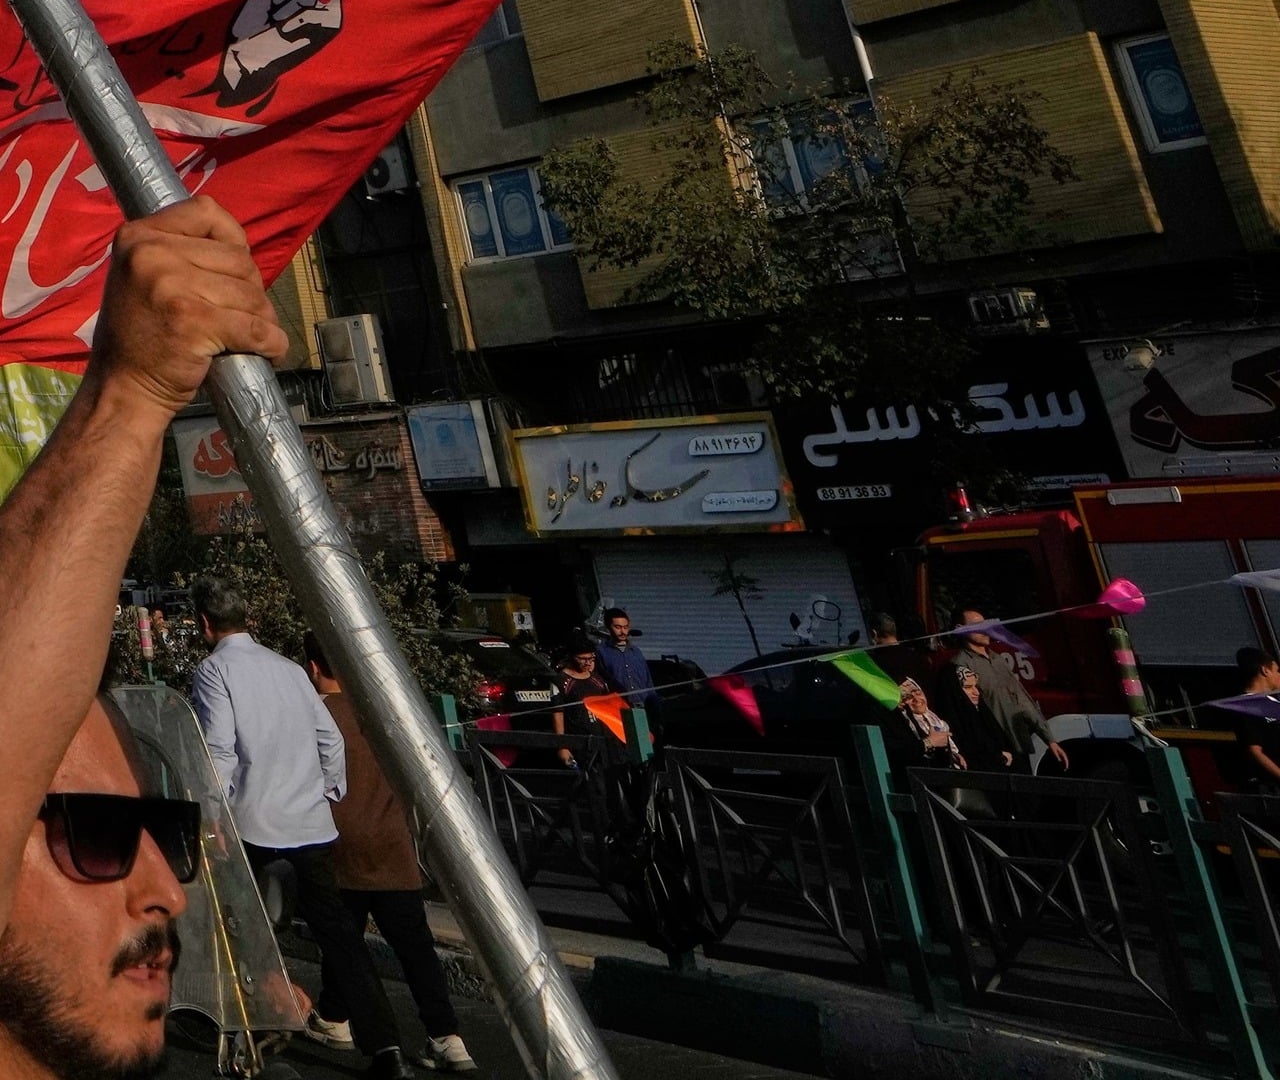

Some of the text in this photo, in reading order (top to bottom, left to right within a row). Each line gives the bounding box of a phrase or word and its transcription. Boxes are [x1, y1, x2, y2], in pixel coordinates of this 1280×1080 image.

[547, 432, 710, 524] سکه خاطره
[821, 486, 887, 499] 88 91 36 93
